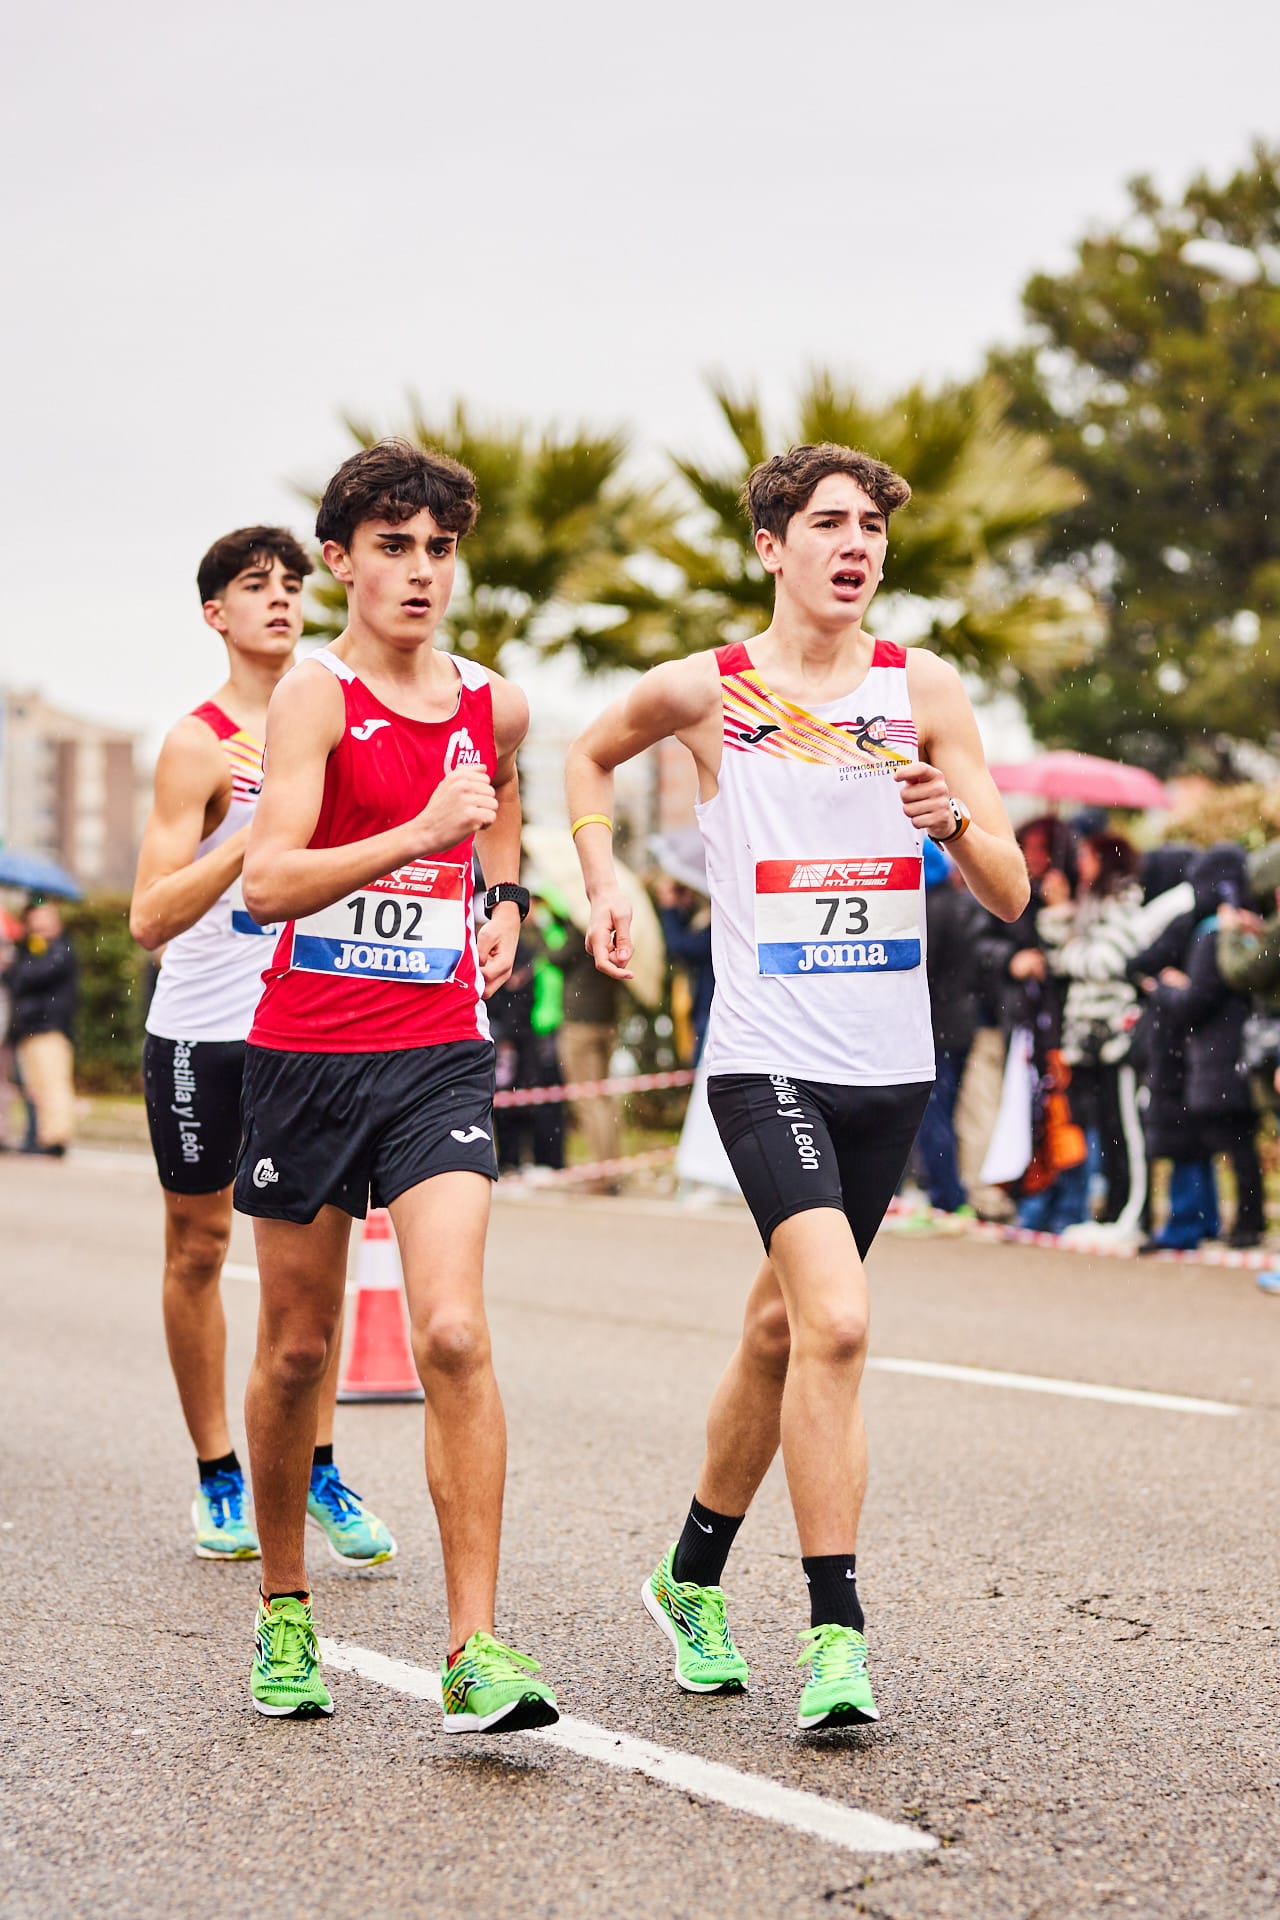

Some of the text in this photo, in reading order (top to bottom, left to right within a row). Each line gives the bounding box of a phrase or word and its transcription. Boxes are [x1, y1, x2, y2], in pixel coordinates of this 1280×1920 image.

[457, 749, 481, 764] FNA
[853, 768, 890, 779] CASTILLA
[826, 862, 894, 880] RFEA
[823, 877, 888, 887] ATLETISMO
[347, 896, 423, 941] 102
[815, 896, 869, 936] 73
[170, 1103, 195, 1119] y
[776, 1107, 805, 1119] y
[178, 1121, 204, 1163] León
[790, 1122, 821, 1170] León
